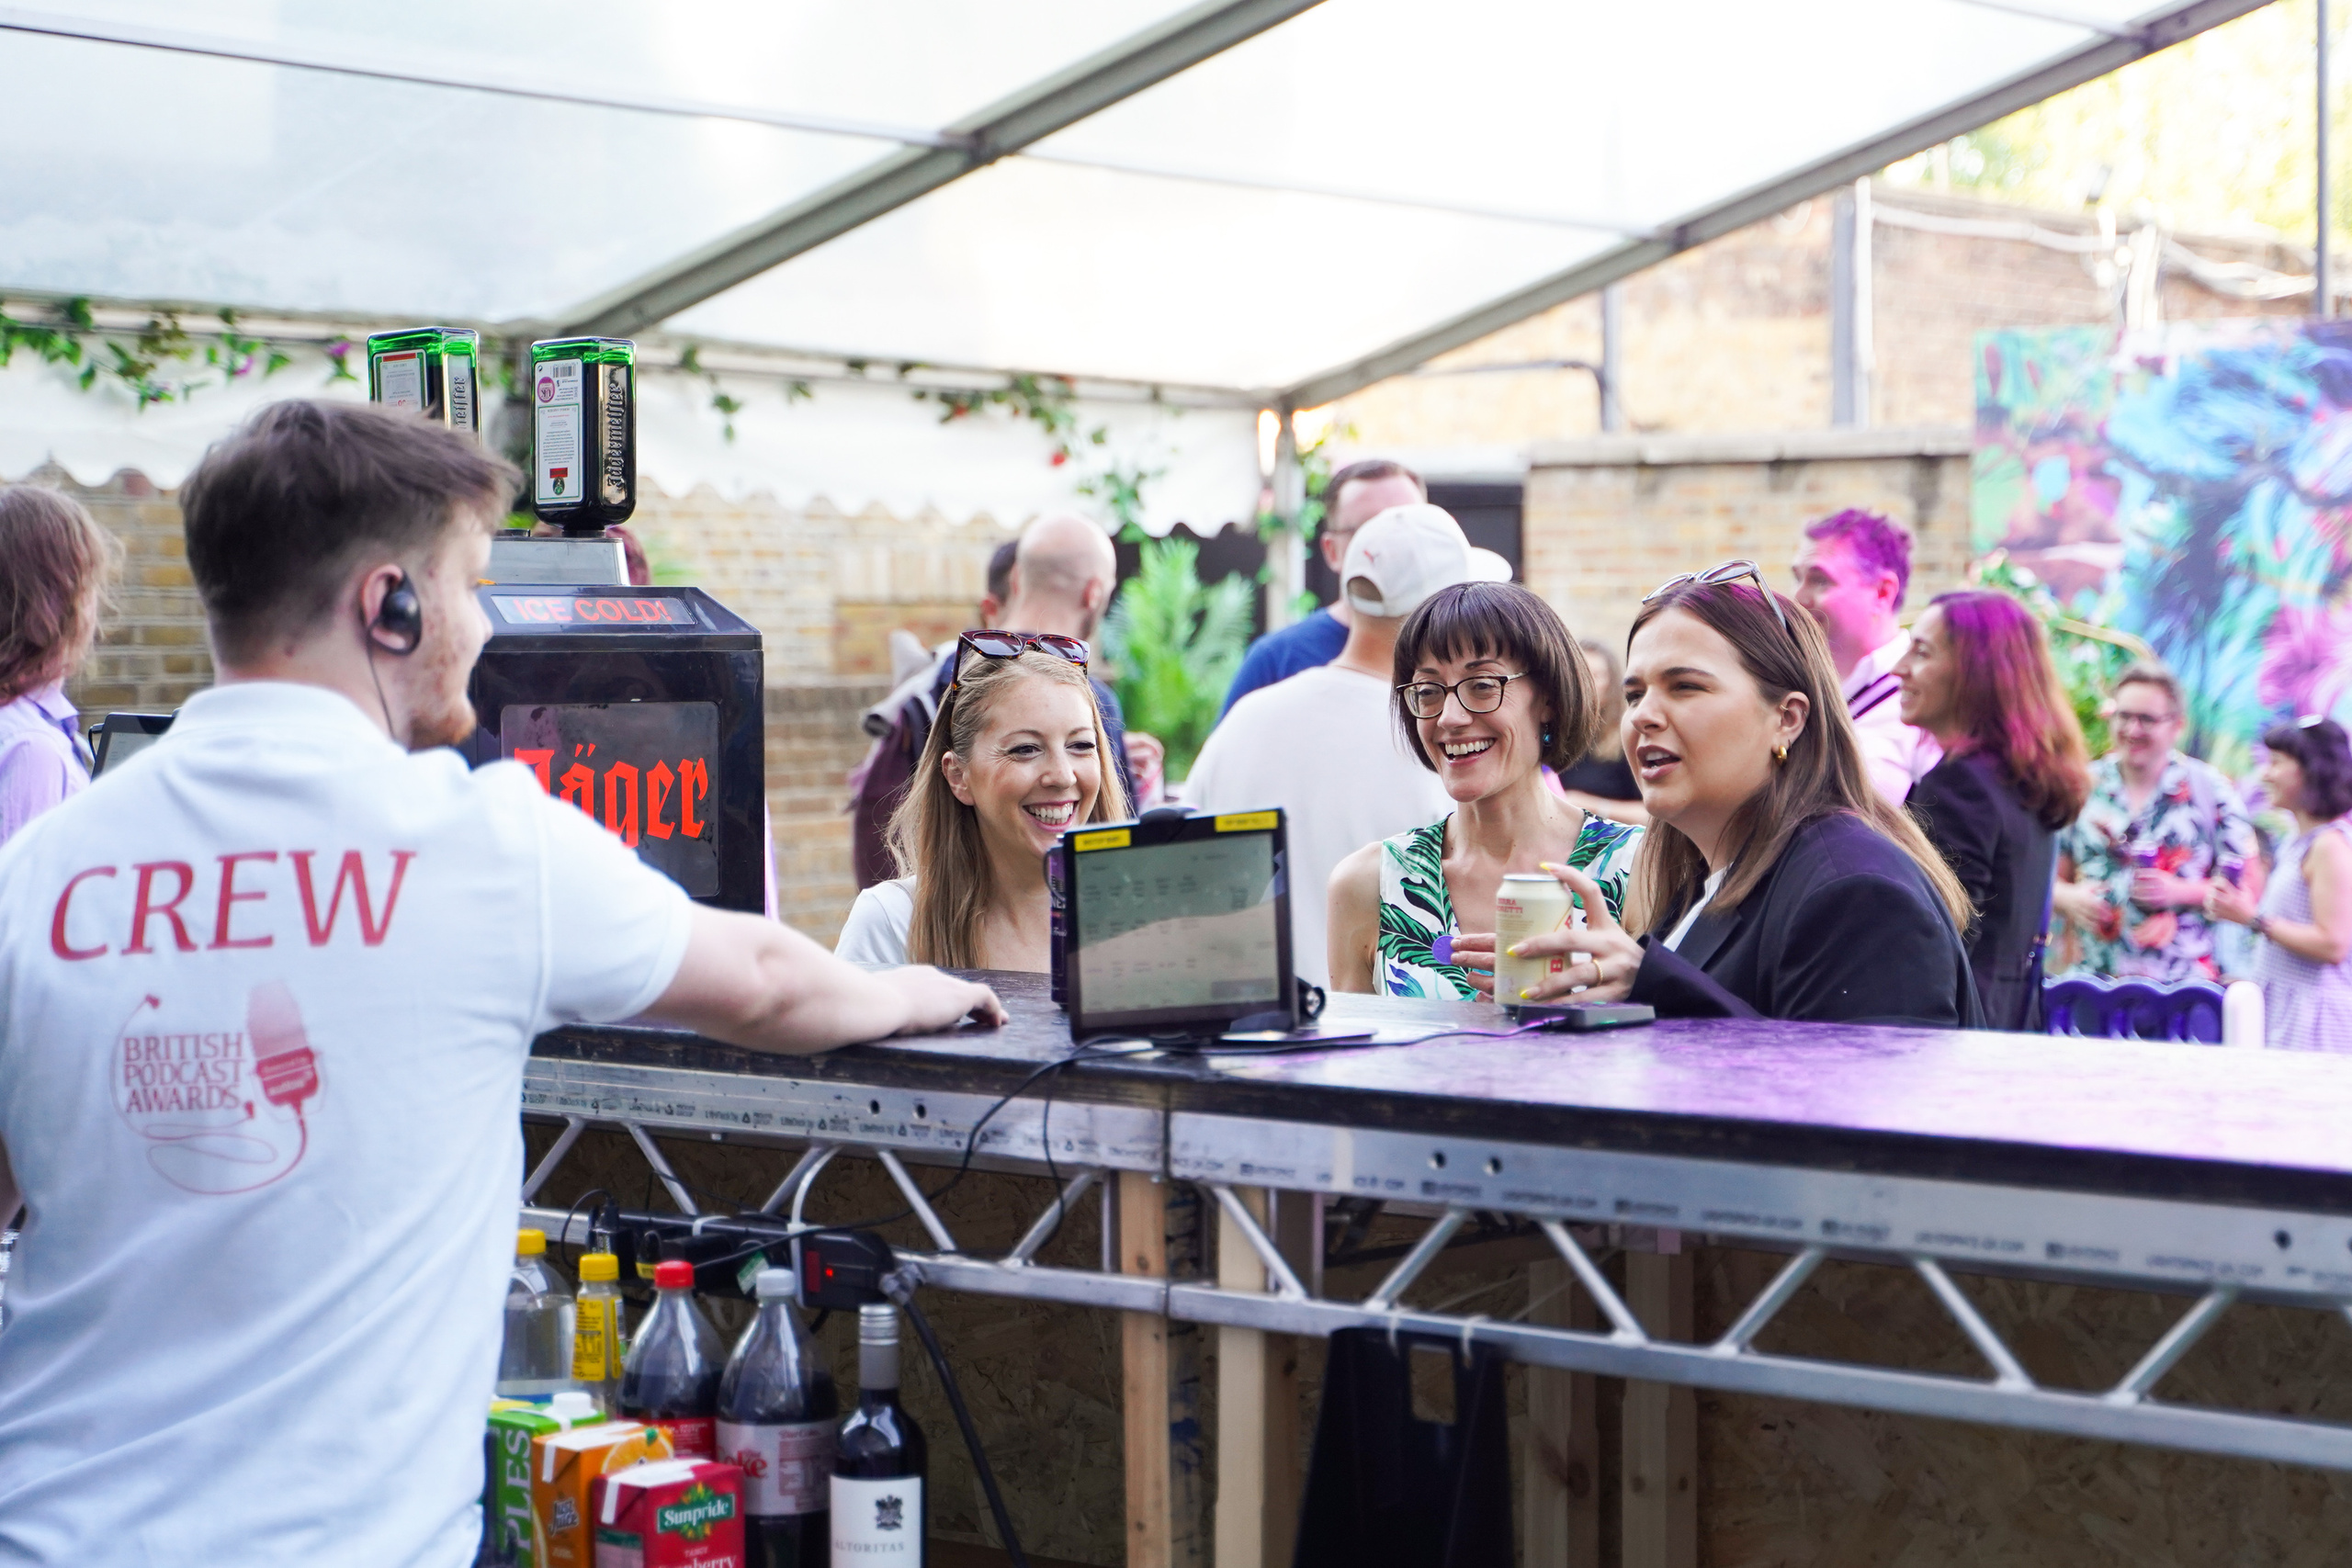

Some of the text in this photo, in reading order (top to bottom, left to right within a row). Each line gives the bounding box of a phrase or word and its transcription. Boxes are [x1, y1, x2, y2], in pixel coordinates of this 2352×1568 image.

[514, 599, 673, 622] ICE COLD!
[51, 848, 418, 962] CREW
[123, 1031, 245, 1063] BRITISH
[122, 1058, 247, 1088] PODCAST
[126, 1084, 241, 1113] AWARDS
[718, 1446, 768, 1478] oke
[664, 1498, 729, 1528] Sunpride
